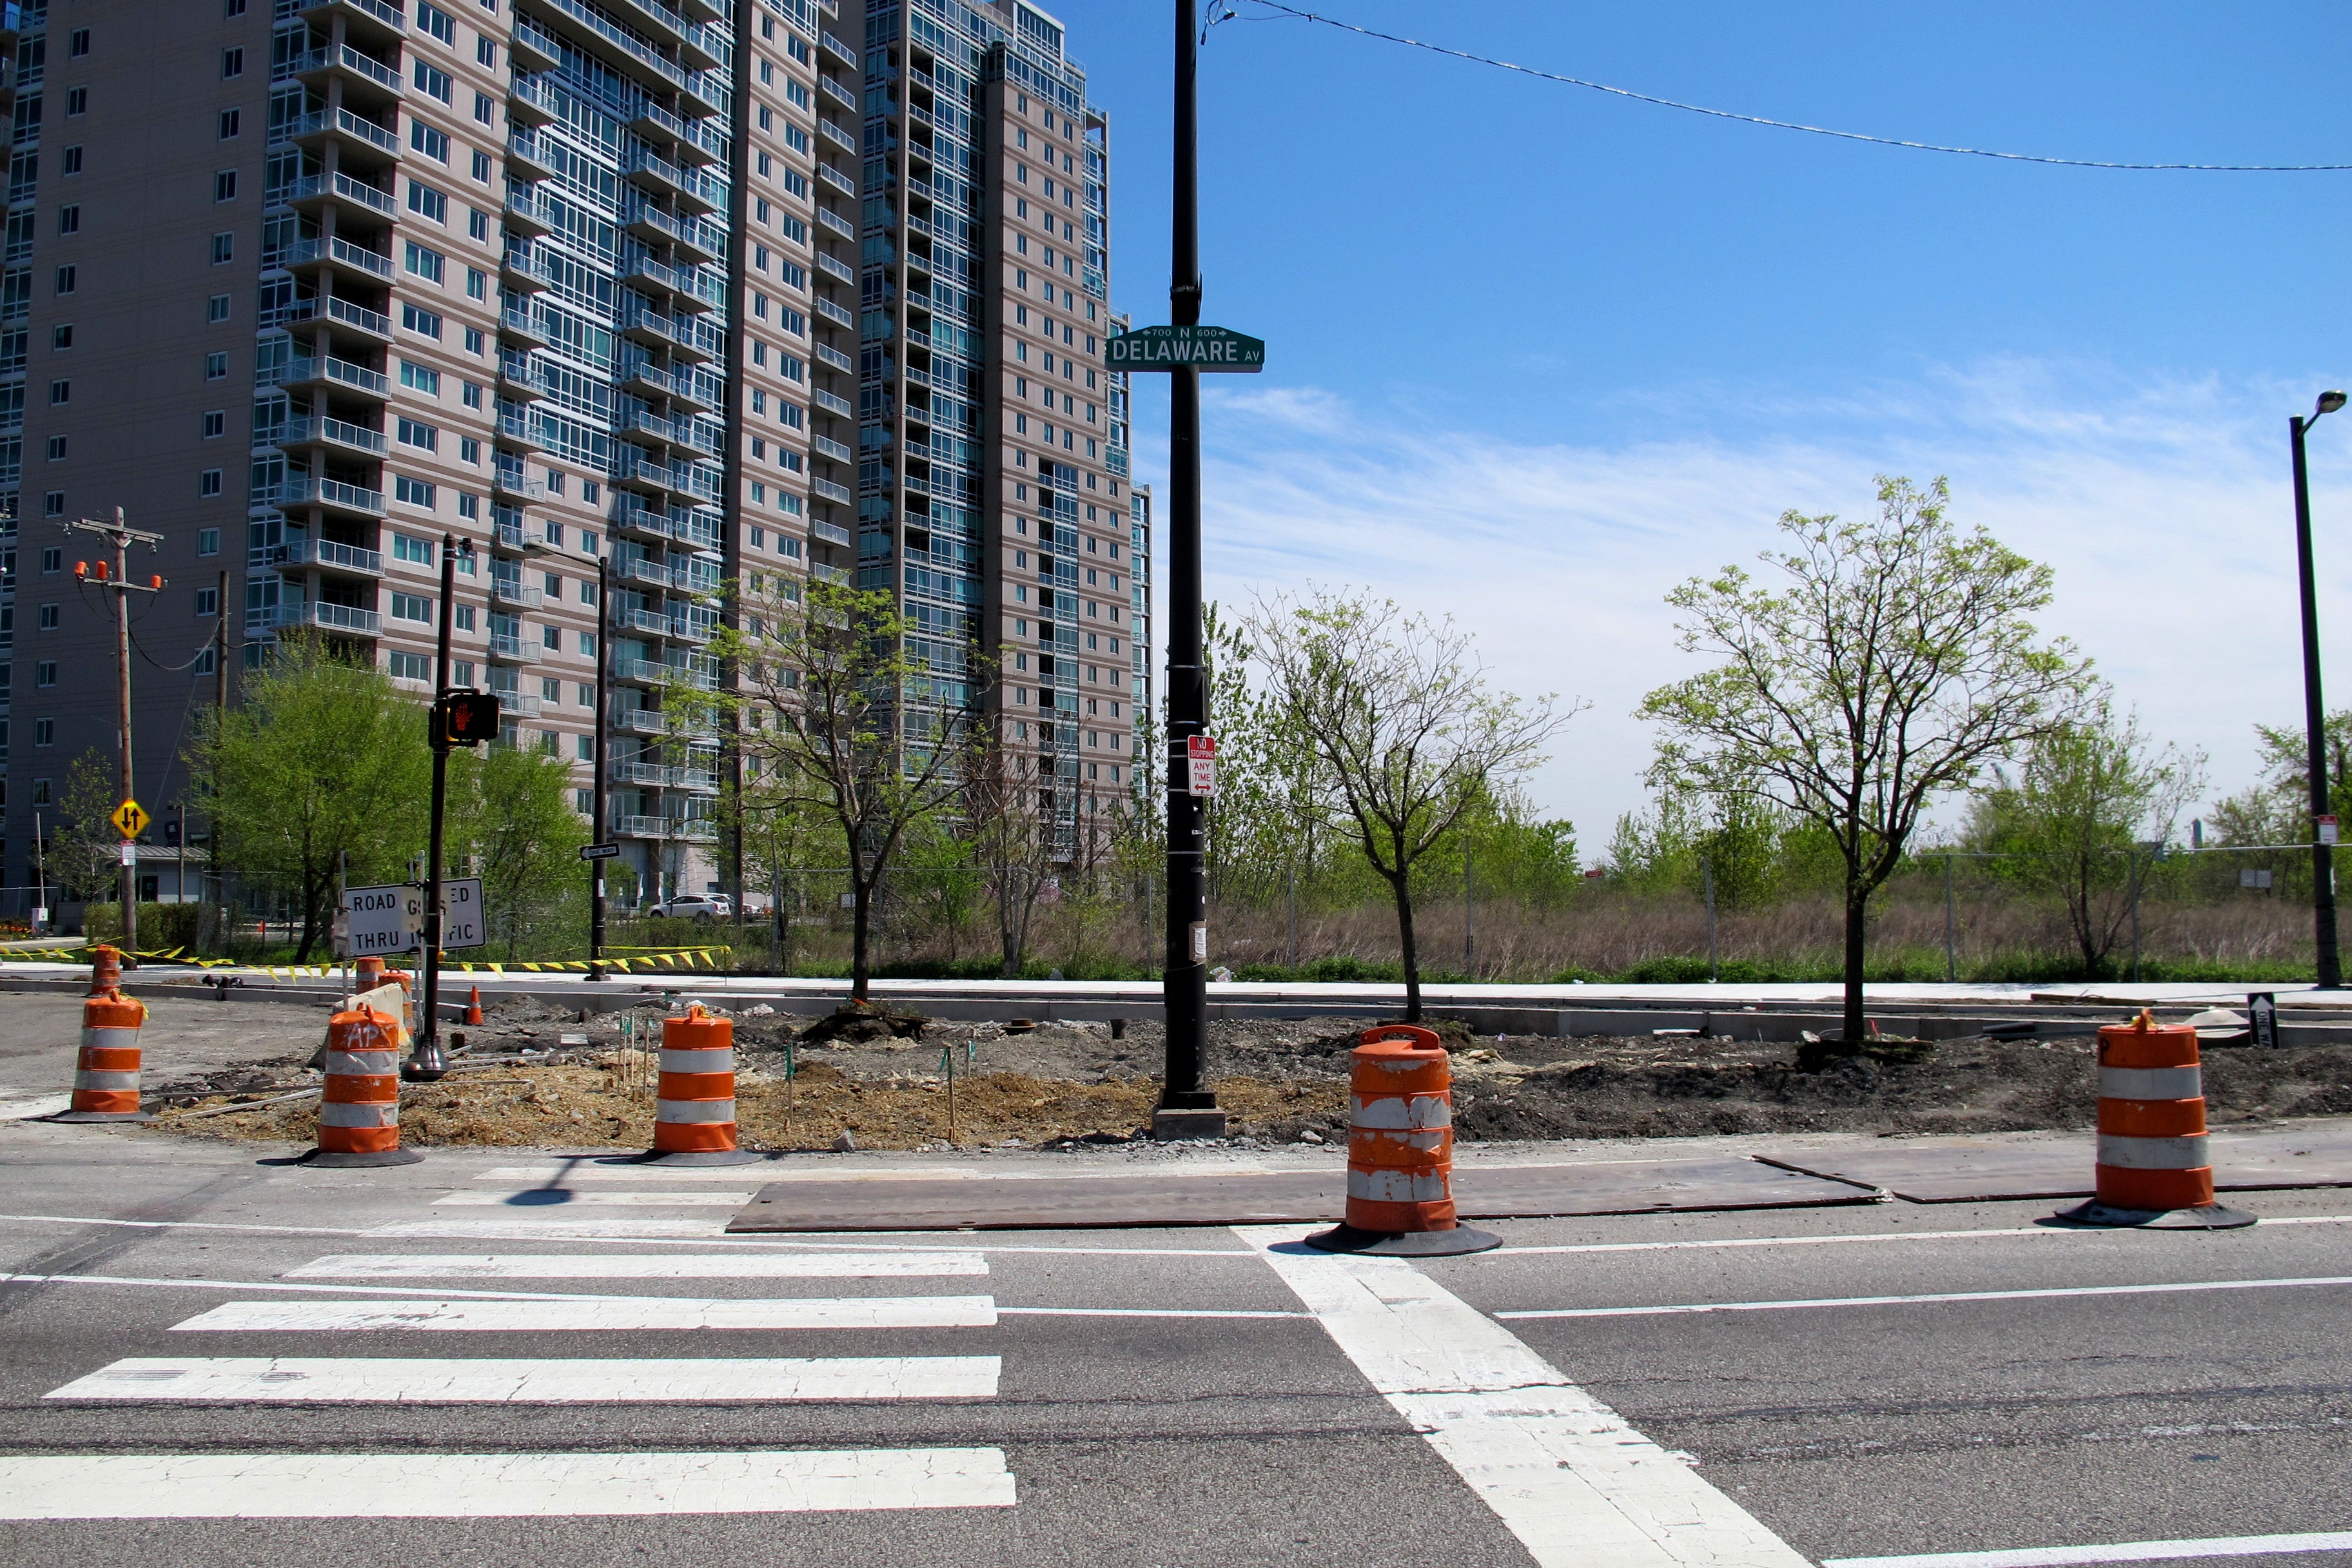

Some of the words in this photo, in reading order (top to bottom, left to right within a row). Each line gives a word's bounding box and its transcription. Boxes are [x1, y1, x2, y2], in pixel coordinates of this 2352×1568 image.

[1180, 328, 1190, 338] N
[1197, 329, 1217, 337] 600
[1113, 340, 1238, 361] DELAWARE
[1244, 351, 1260, 361] AV
[1197, 738, 1206, 749] NO
[1190, 750, 1213, 758] STOPPING
[1194, 762, 1210, 770] ANY
[1193, 772, 1210, 781] TIME
[354, 894, 396, 912] ROAD
[356, 931, 398, 949] THRU
[2258, 1012, 2269, 1030] ONE
[2259, 1034, 2271, 1046] WA
